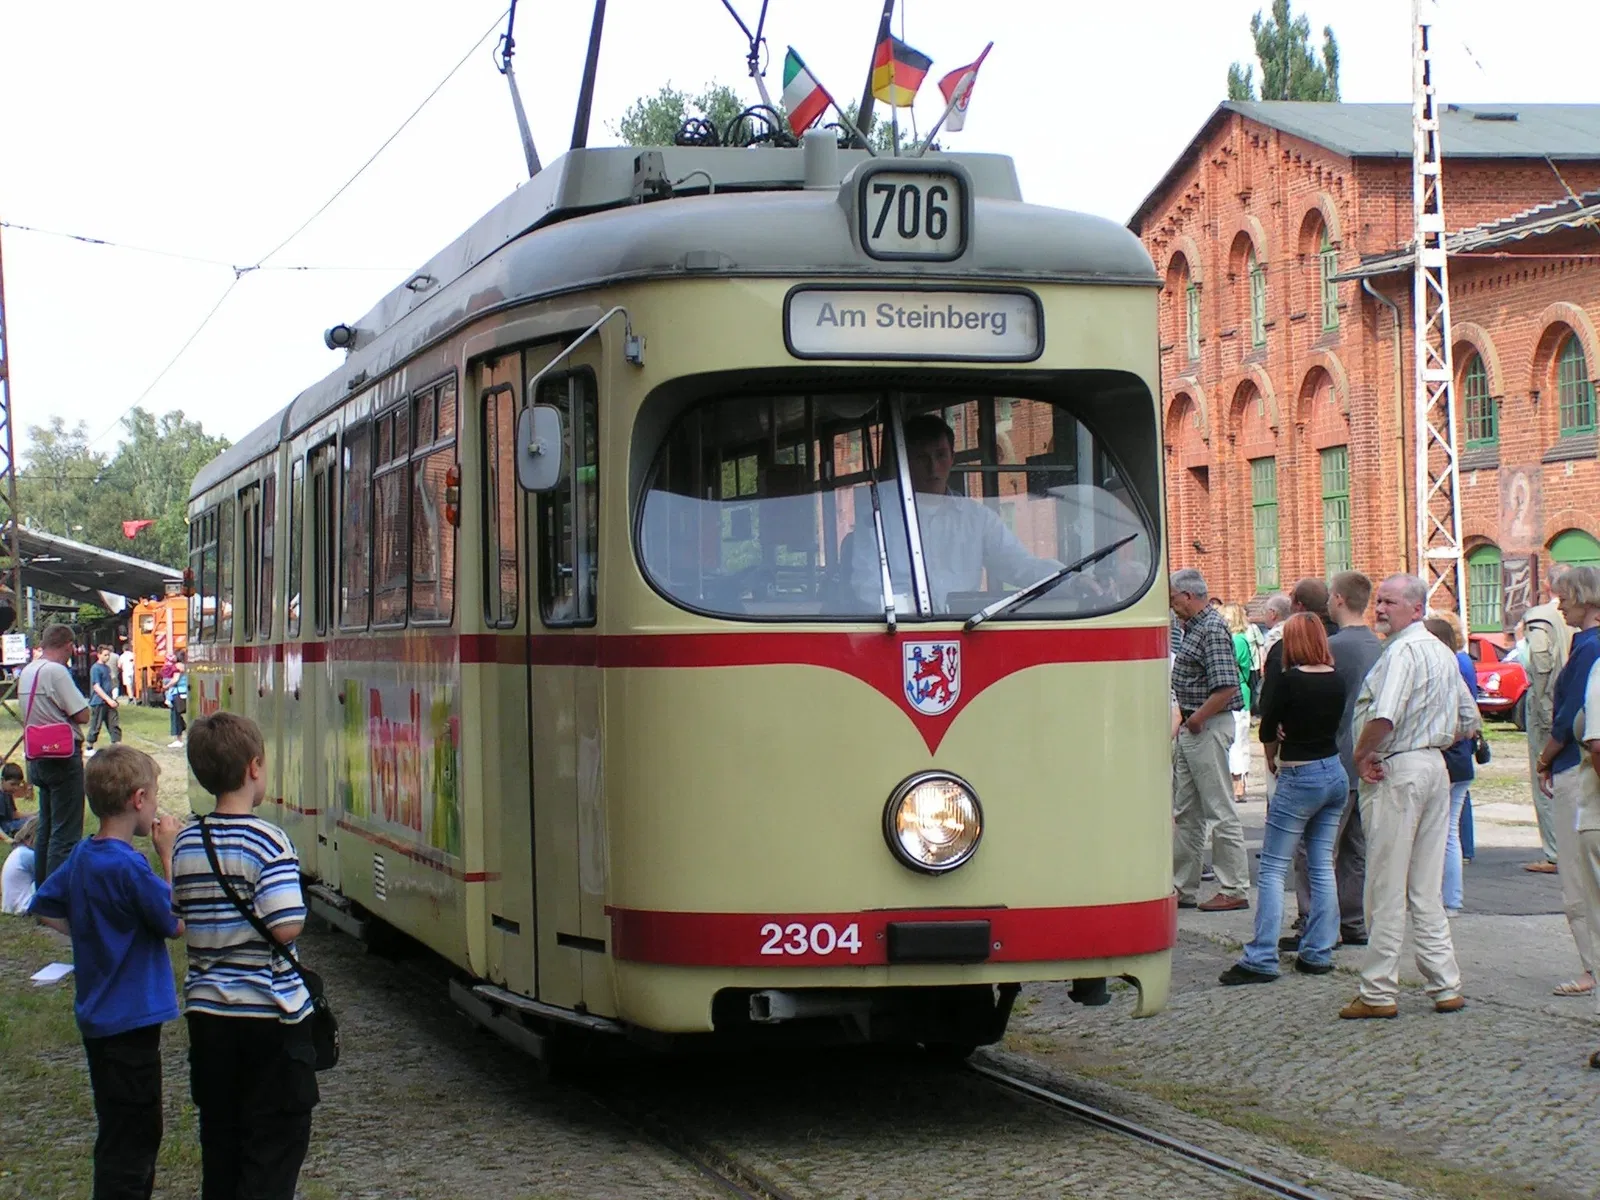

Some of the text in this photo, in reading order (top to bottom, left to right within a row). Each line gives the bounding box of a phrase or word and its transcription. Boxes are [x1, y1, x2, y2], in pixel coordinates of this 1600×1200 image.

[871, 183, 949, 241] 706
[815, 301, 1008, 336] Am Steinberg
[760, 922, 863, 955] 2304
